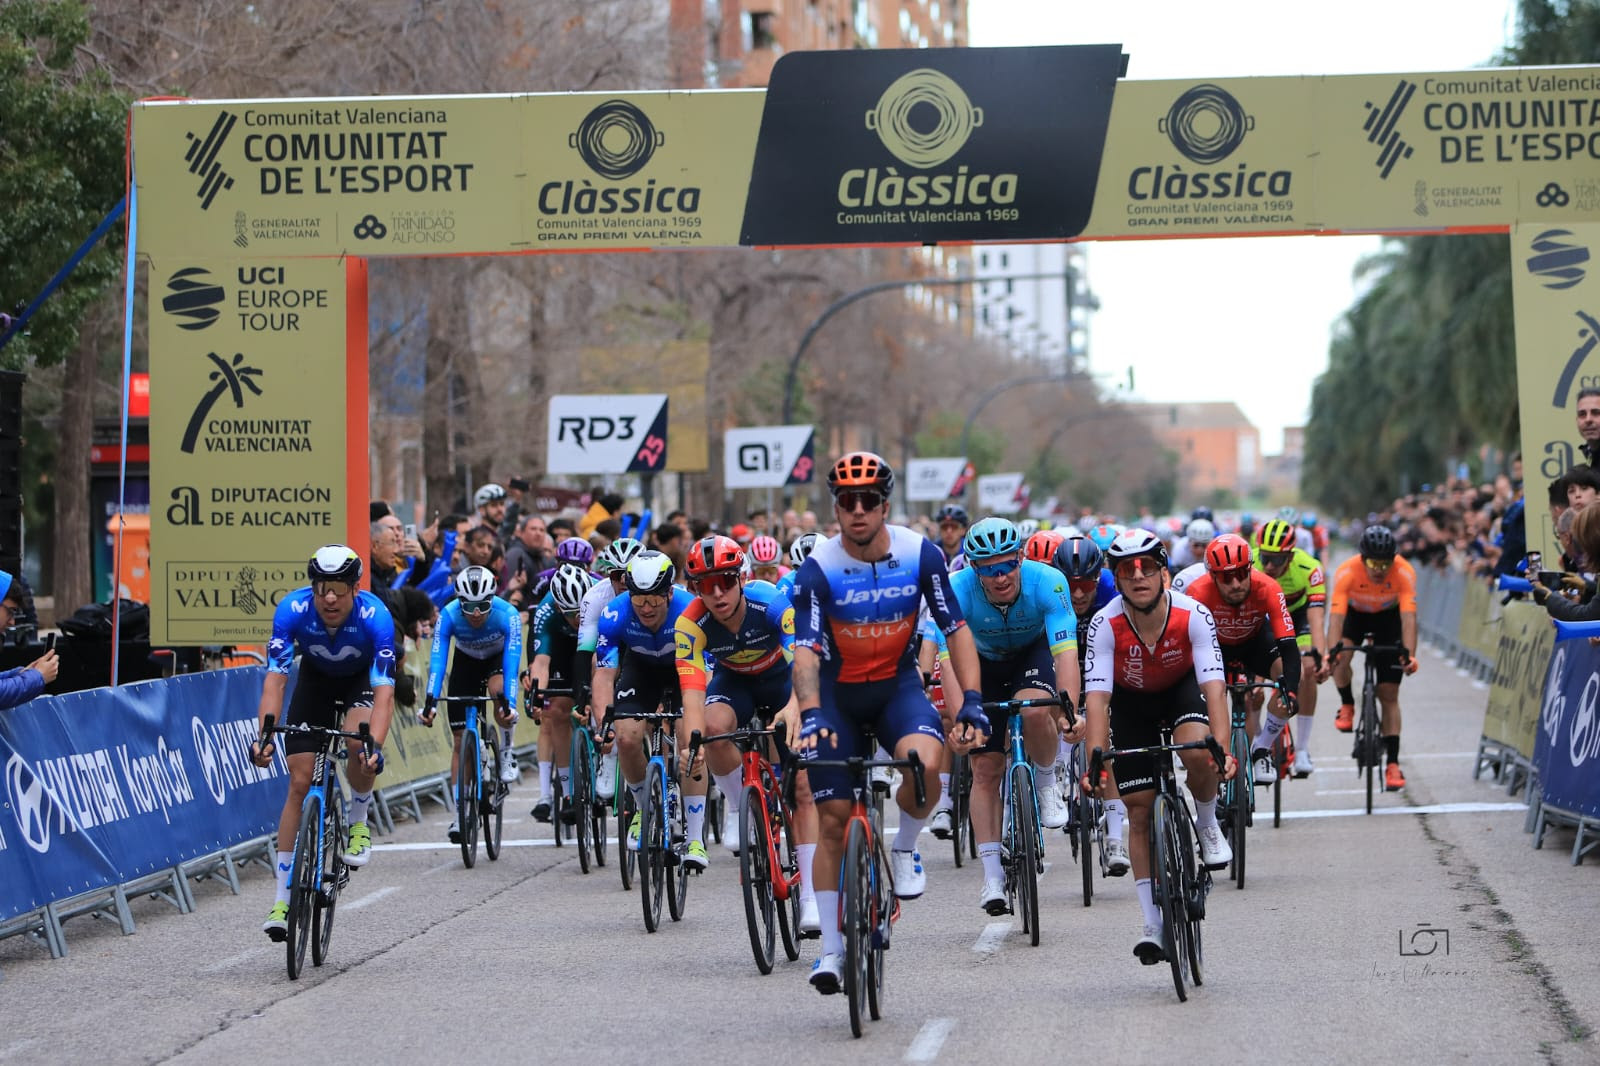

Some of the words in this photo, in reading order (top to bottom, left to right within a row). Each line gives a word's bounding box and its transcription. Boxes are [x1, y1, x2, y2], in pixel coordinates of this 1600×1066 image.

[1424, 77, 1522, 96] Comunitat
[245, 109, 342, 127] Comunitat
[346, 107, 447, 125] Valenciana
[244, 131, 447, 163] COMUNITAT
[1440, 135, 1484, 163] DE
[260, 167, 303, 195] DE
[837, 166, 1018, 208] Clàssica
[1128, 163, 1292, 201] Clàssica
[537, 179, 701, 215] Clàssica
[1432, 186, 1503, 198] GENERALITAT
[1126, 202, 1190, 215] Comunitat
[1193, 200, 1260, 214] Valenciana
[1263, 200, 1294, 212] 1969
[1433, 196, 1501, 208] VALENCIANA
[251, 217, 321, 230] GENERALITAT
[391, 216, 456, 231] TRINIDAD
[537, 216, 600, 229] Comunitat
[602, 215, 668, 229] Valenciana
[671, 215, 702, 227] 1969
[837, 210, 906, 224] Comunitat
[909, 209, 982, 224] Valenciana
[985, 208, 1019, 222] 1969
[1128, 216, 1170, 227] GRAN
[1174, 215, 1219, 225] PREMI
[1225, 212, 1295, 225] VALÈNCIA
[253, 227, 320, 240] VALENCIANA
[391, 231, 456, 244] ALFONSO
[537, 230, 584, 241] GRAN
[589, 230, 628, 241] PREMI
[631, 227, 702, 240] VALÈNCIA
[238, 266, 285, 285] UCI
[238, 290, 328, 308] EUROPE
[238, 313, 300, 331] TOUR
[208, 419, 312, 435] COMUNITAT
[558, 416, 637, 450] RD3
[205, 437, 313, 452] VALENCIANA
[211, 484, 331, 504] DIPUTACIÓN
[211, 512, 234, 527] DE
[241, 511, 331, 527] ALICANTE
[835, 584, 918, 606] Jayco
[1277, 592, 1295, 632] ARKEA
[213, 626, 246, 637] Joventut
[1118, 776, 1153, 789] CORIMA
[36, 748, 130, 835] HYUNDAI
